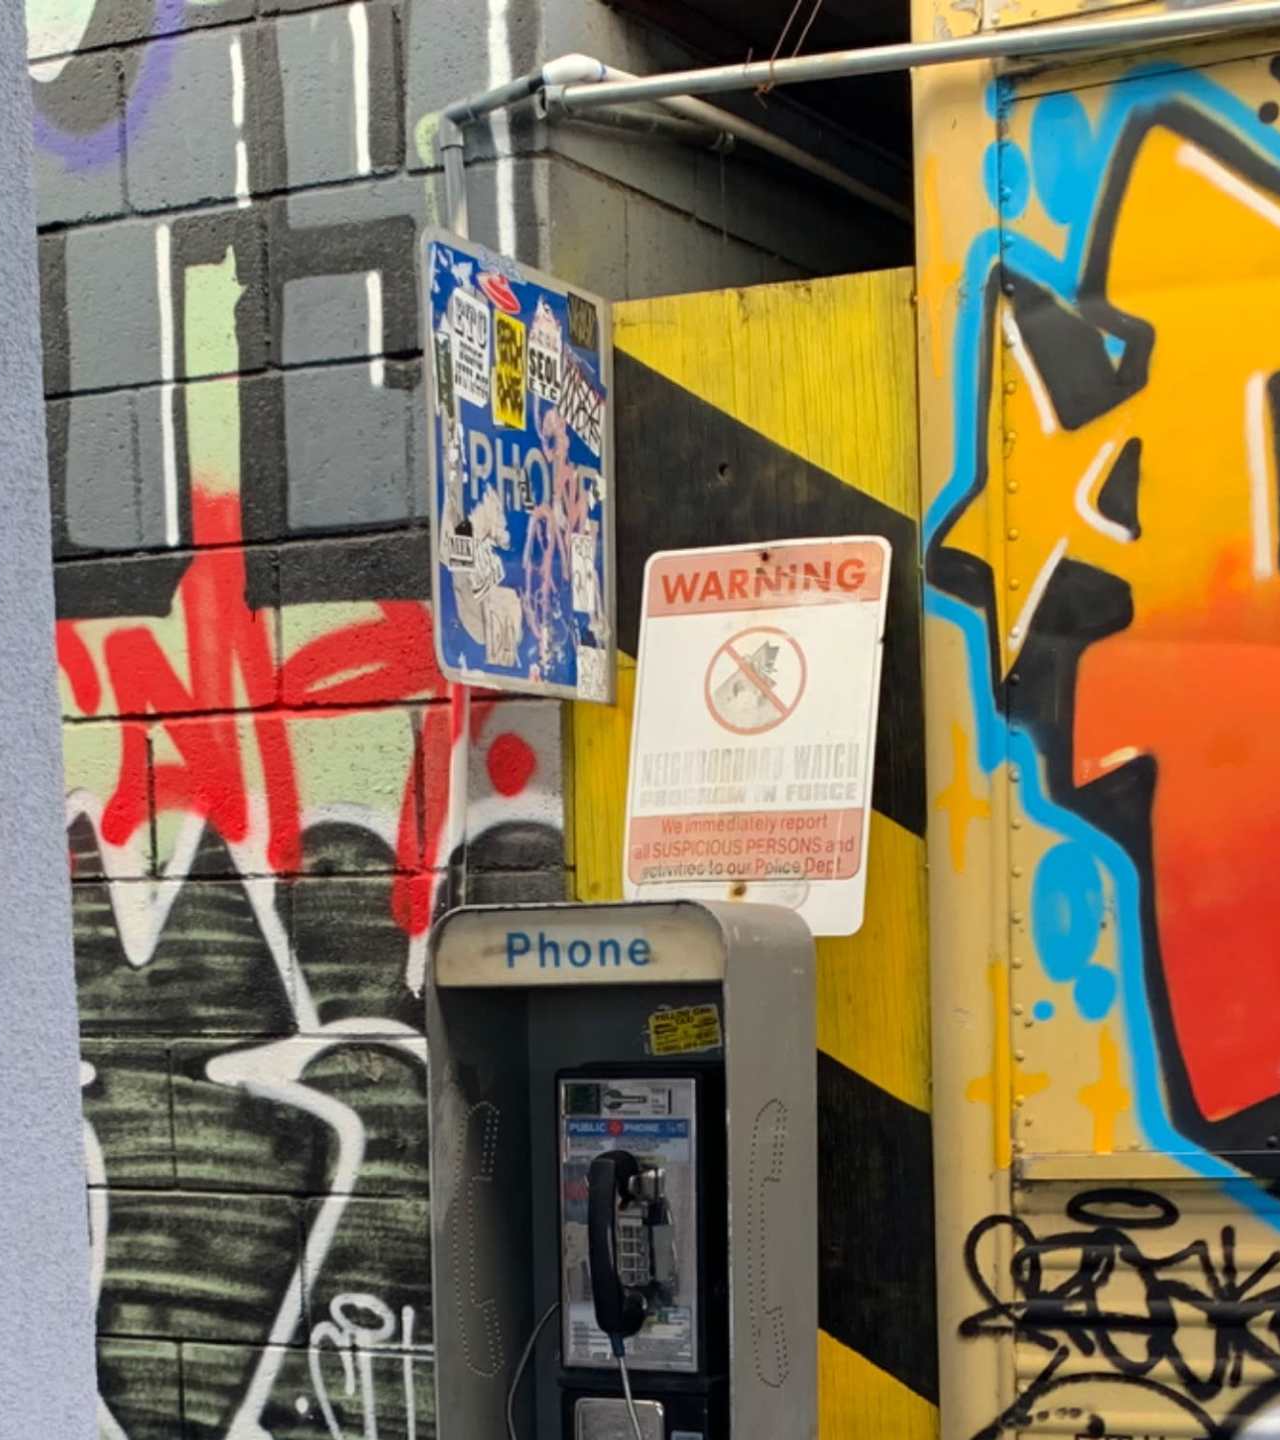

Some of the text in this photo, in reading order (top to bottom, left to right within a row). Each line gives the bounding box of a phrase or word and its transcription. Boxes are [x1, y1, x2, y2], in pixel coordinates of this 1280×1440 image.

[661, 557, 867, 606] WARNING
[660, 813, 829, 836] We immediately report
[652, 838, 744, 860] SUSPICIOUS
[746, 836, 823, 857] PERSONS
[708, 859, 725, 876] to
[754, 857, 801, 875] Police
[506, 931, 651, 969] Phone
